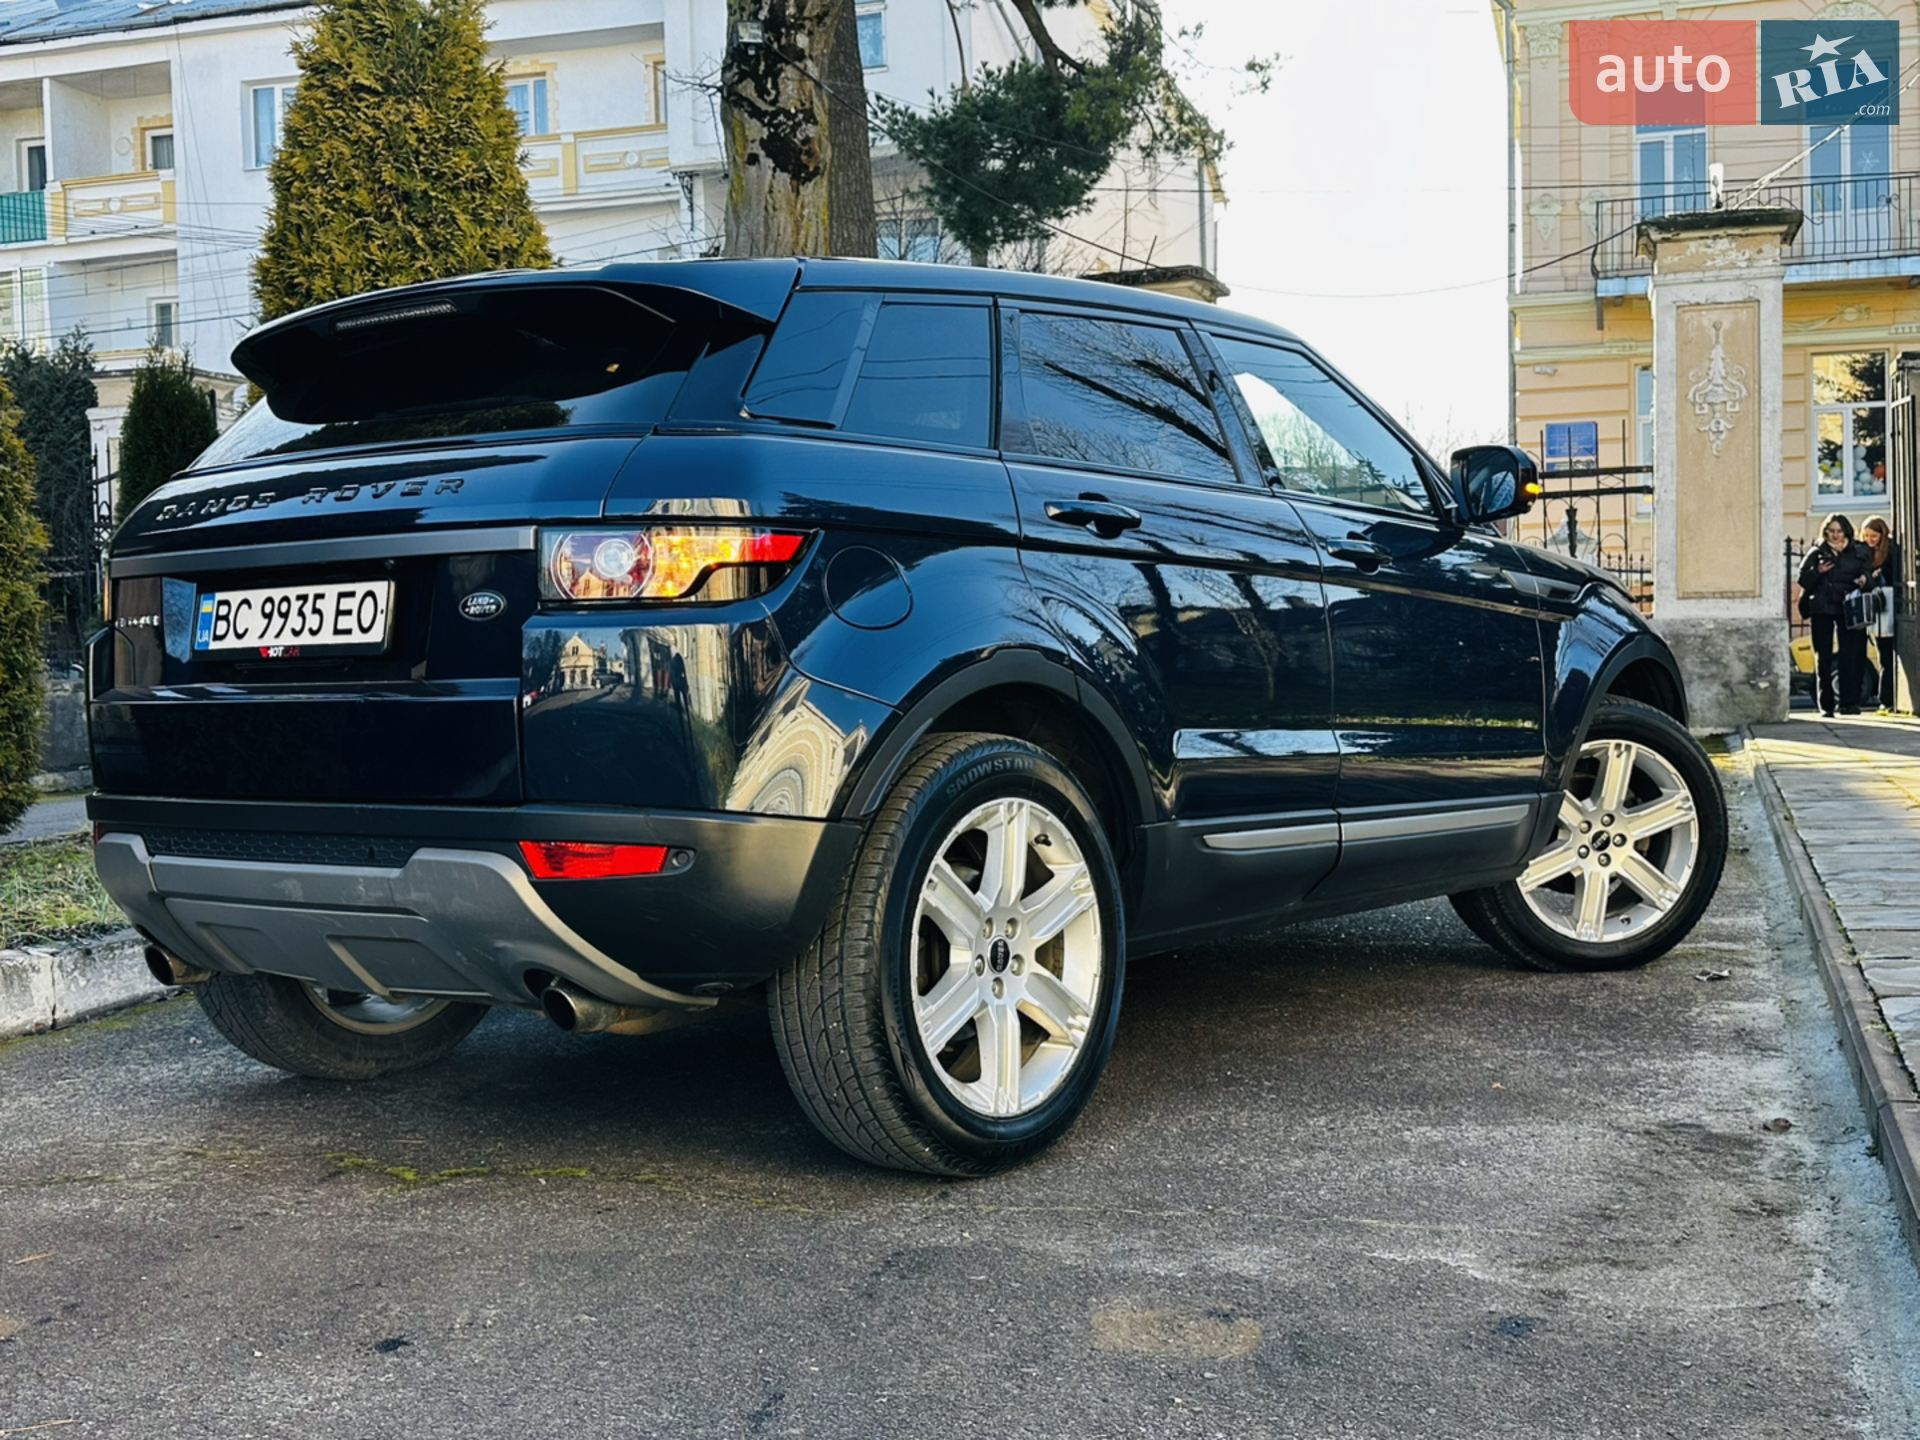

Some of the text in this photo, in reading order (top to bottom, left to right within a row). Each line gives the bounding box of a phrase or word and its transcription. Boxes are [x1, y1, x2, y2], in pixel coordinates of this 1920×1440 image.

[156, 477, 465, 521] RANGE ROVER
[197, 629, 210, 642] UA
[212, 590, 378, 642] BC 9935 EO
